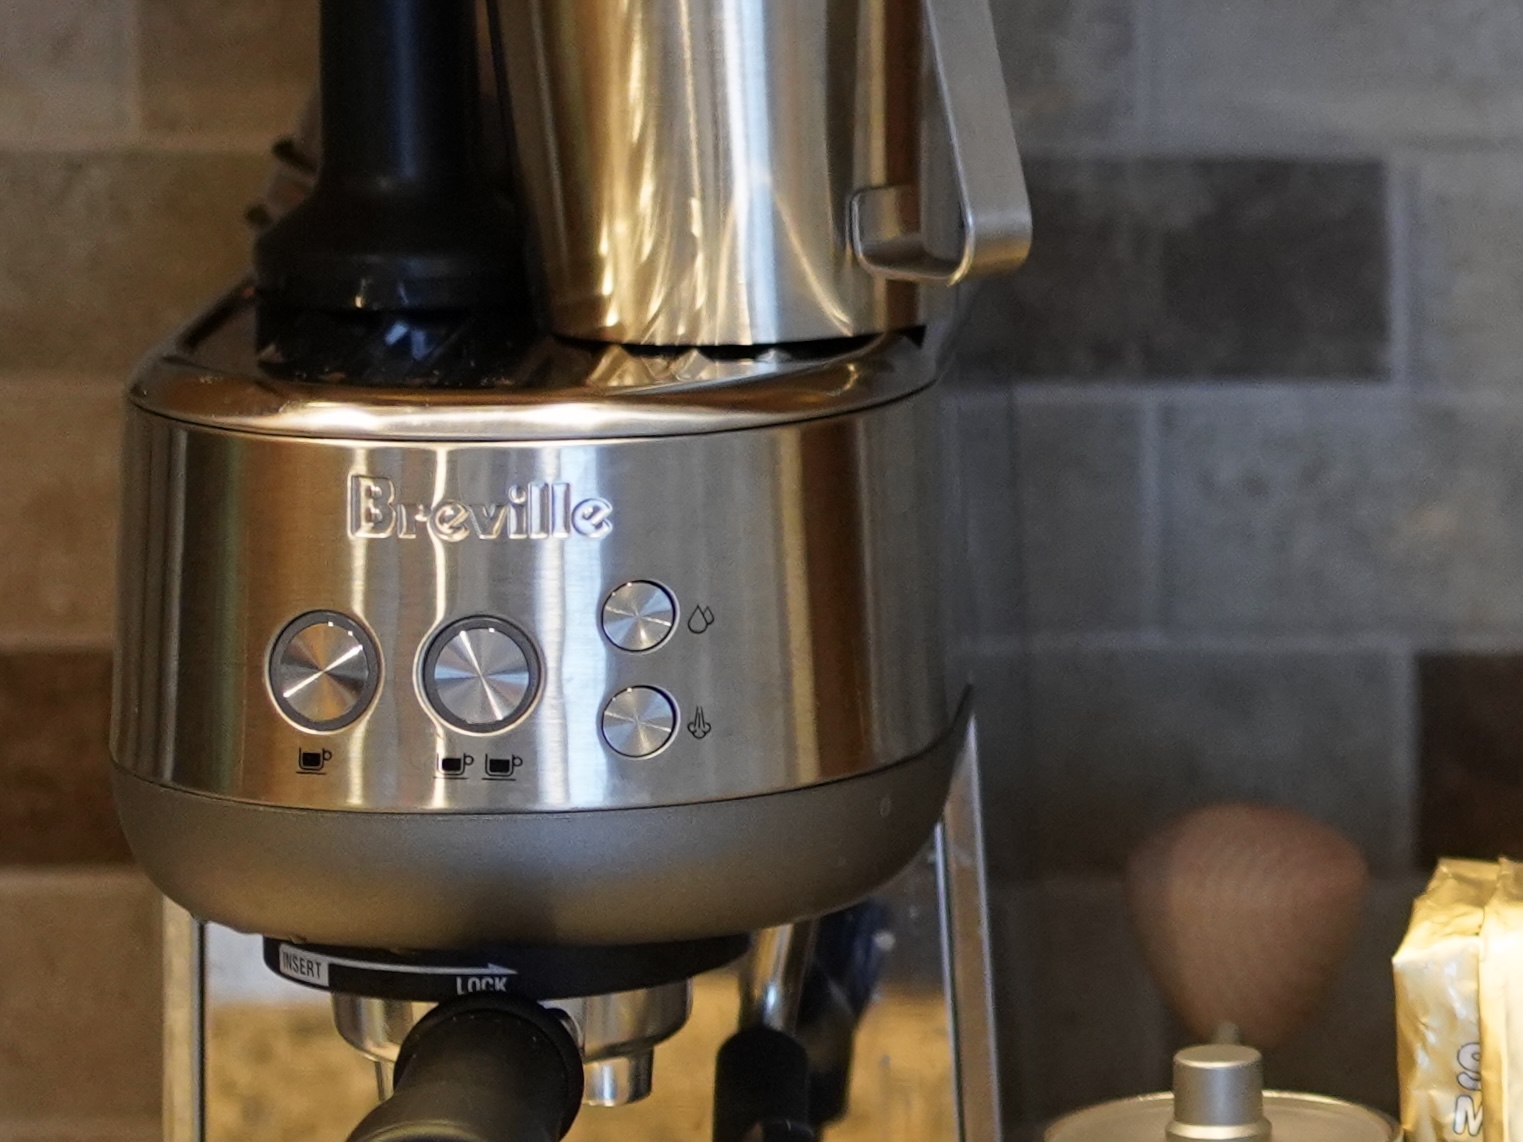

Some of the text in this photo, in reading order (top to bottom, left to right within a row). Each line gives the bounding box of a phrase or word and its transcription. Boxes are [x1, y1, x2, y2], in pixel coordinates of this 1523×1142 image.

[346, 474, 613, 542] Breville
[282, 950, 322, 980] INSERT
[455, 976, 509, 996] LOCK
